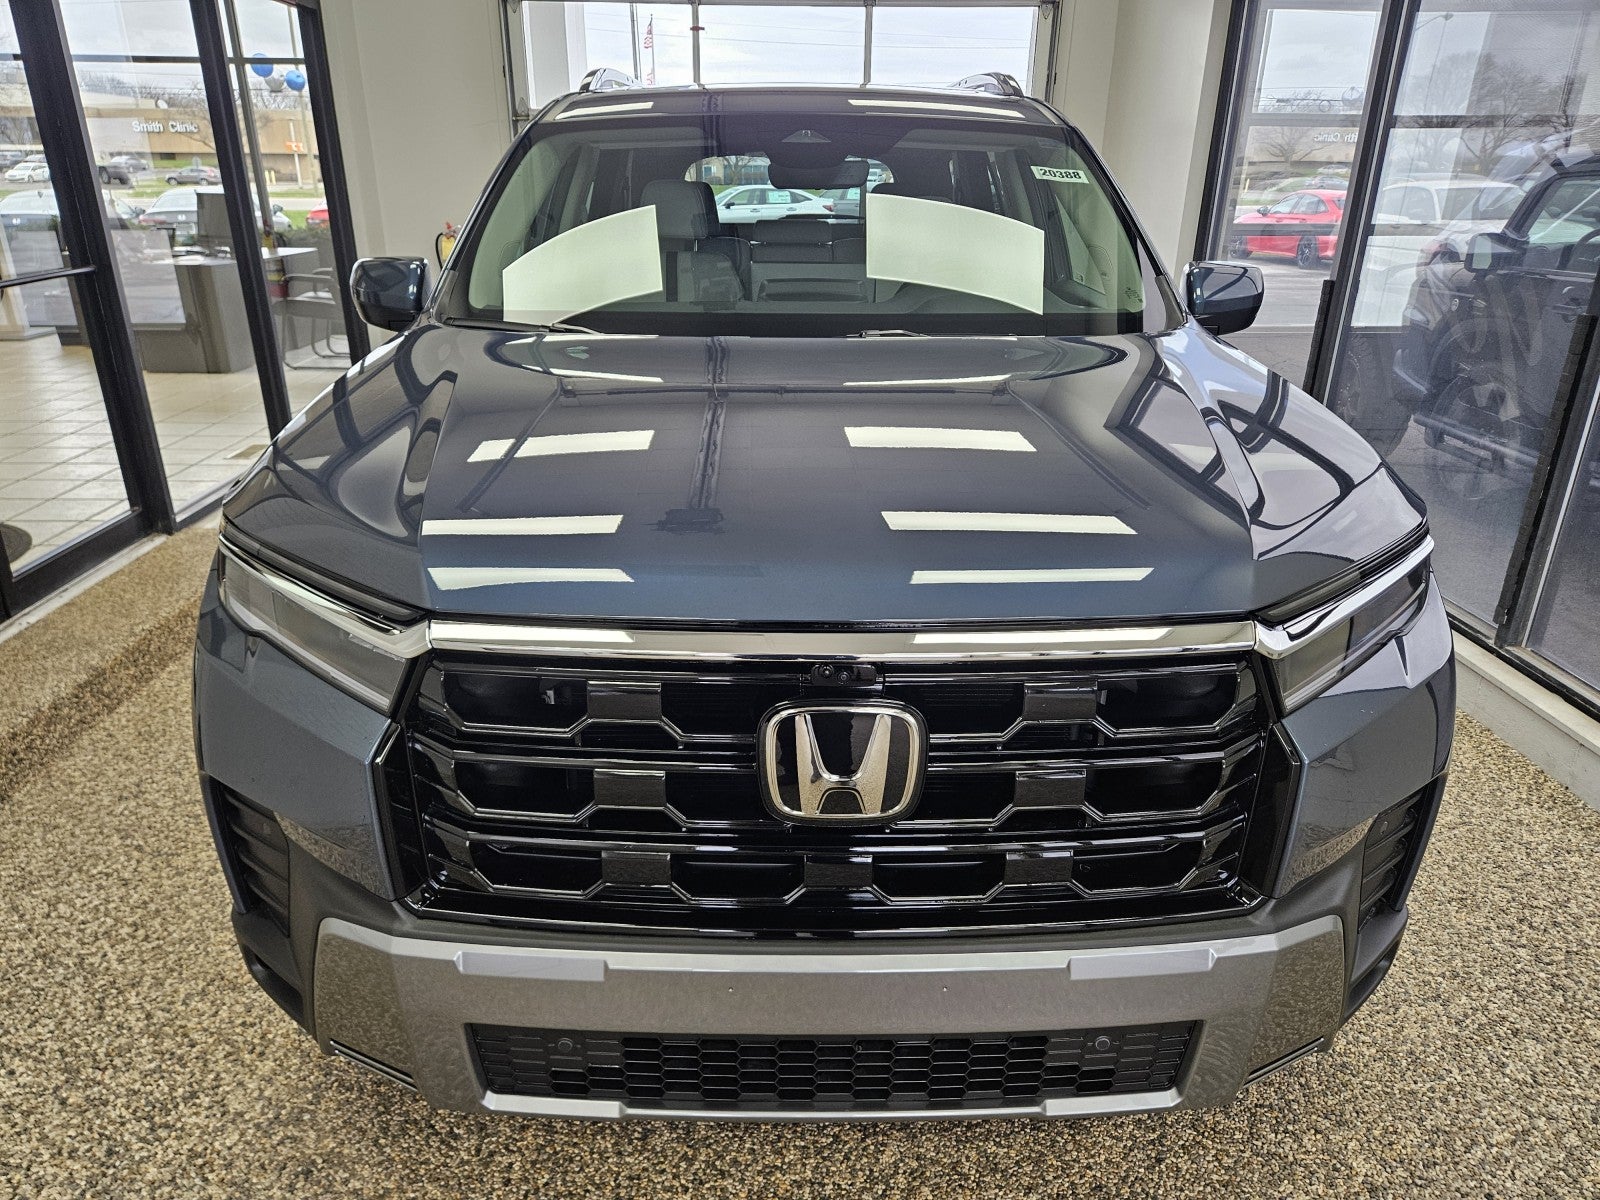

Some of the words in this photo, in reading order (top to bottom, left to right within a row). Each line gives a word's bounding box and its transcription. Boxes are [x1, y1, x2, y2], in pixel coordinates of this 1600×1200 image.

[131, 120, 165, 133] Smith
[168, 120, 200, 133] Clinic
[1039, 168, 1082, 180] 20388
